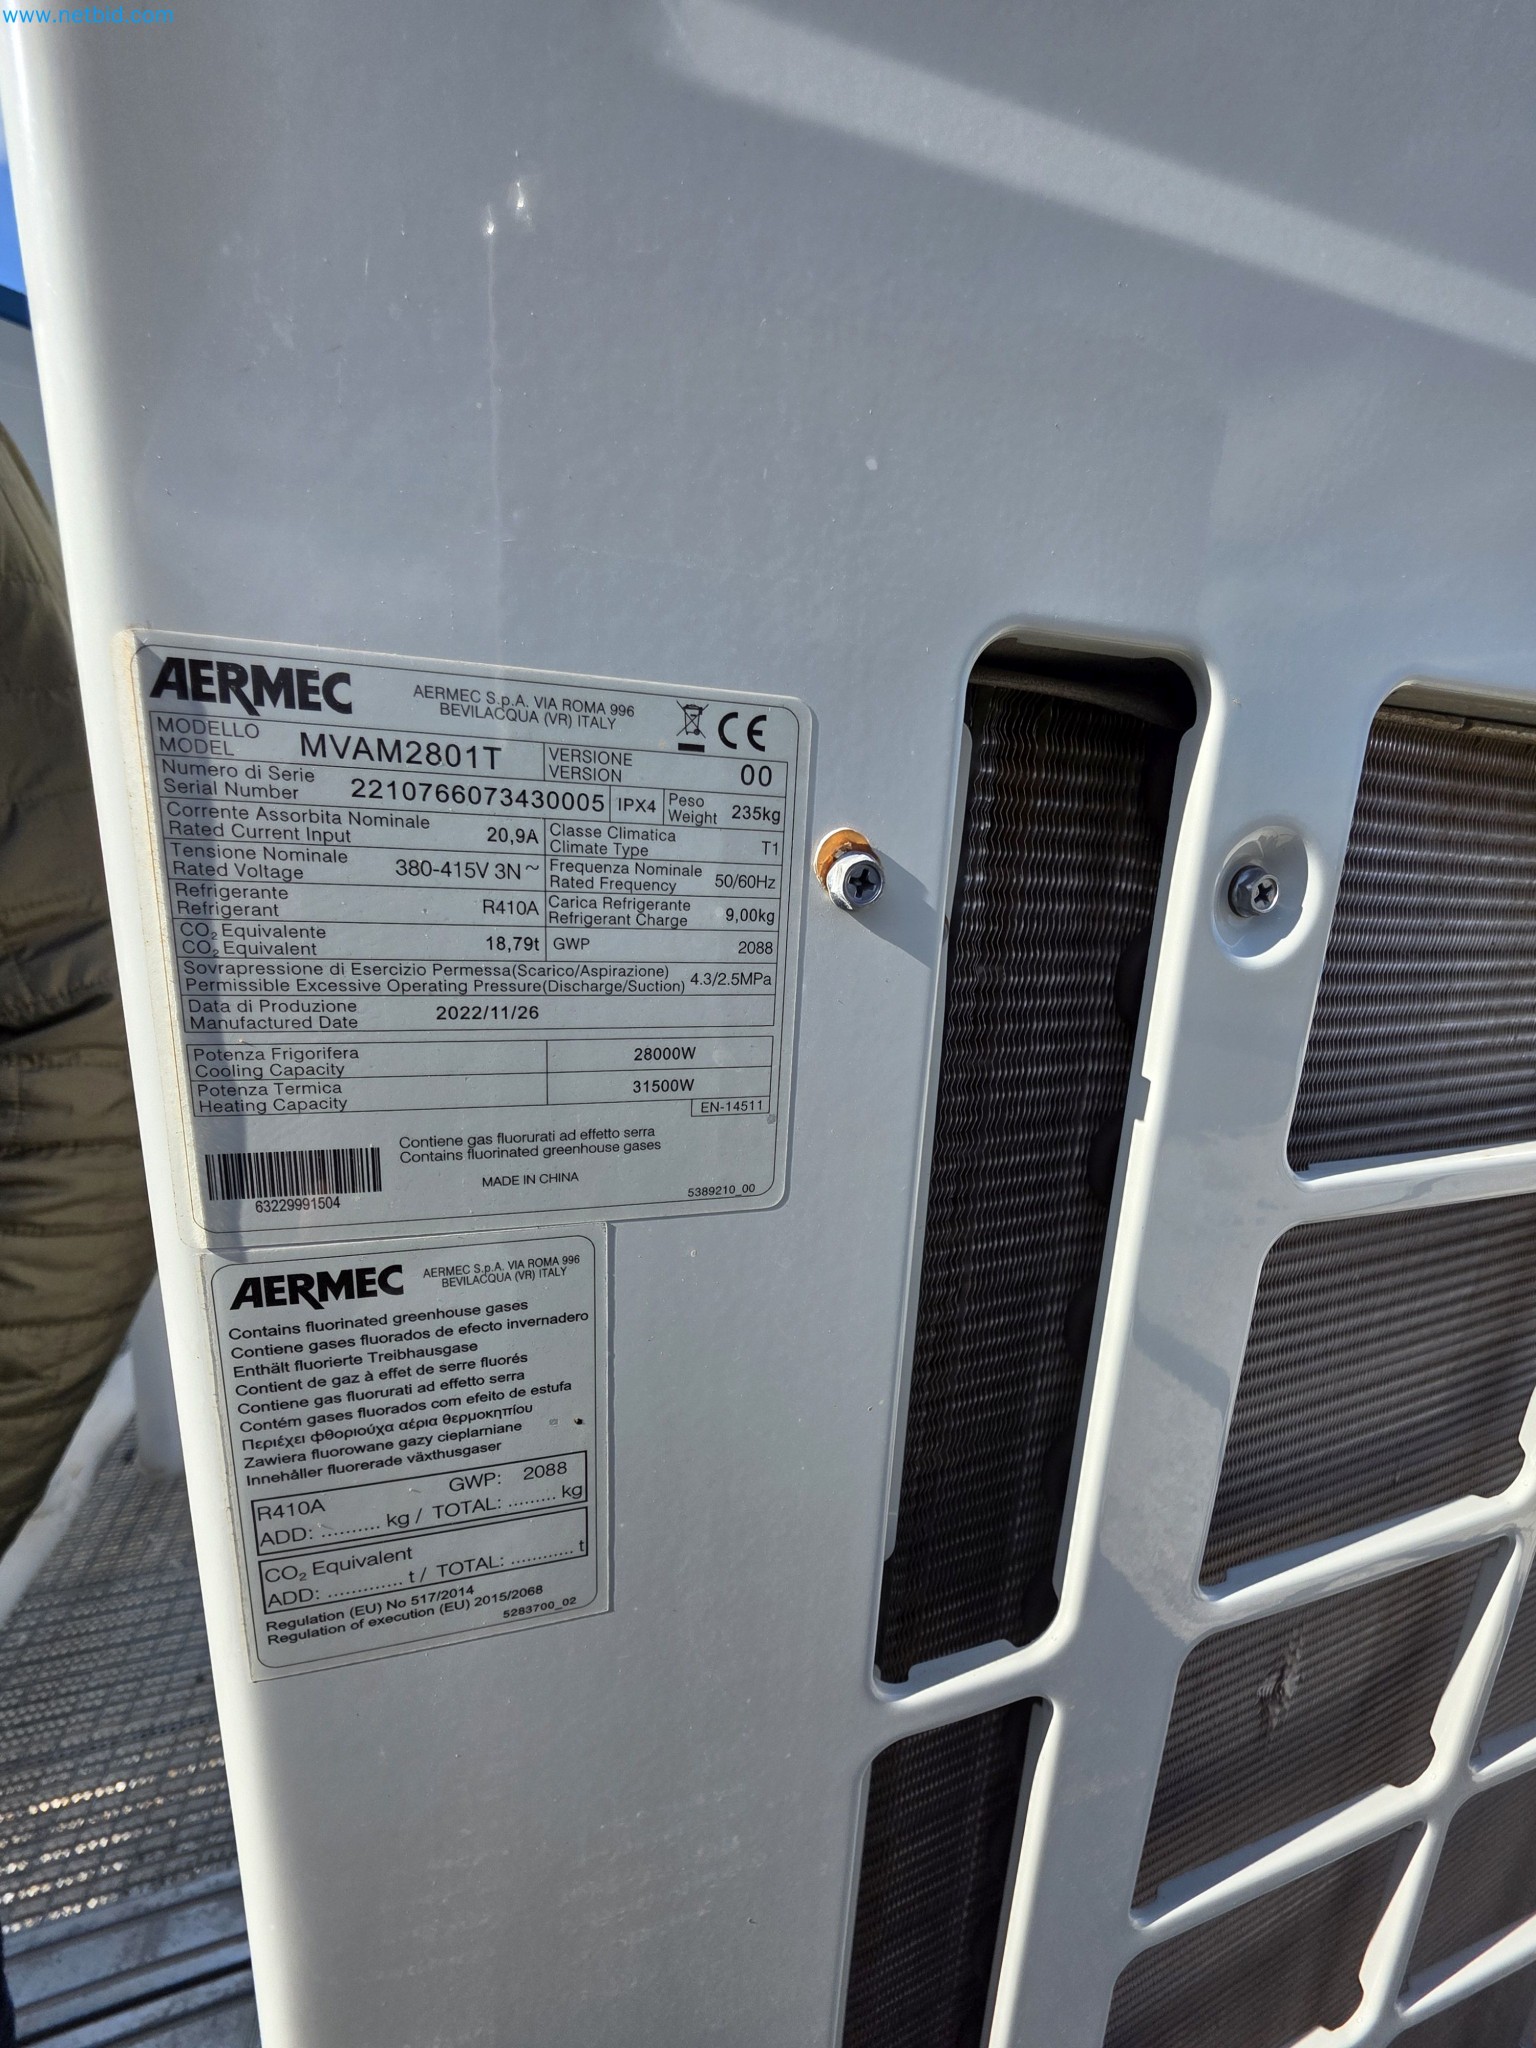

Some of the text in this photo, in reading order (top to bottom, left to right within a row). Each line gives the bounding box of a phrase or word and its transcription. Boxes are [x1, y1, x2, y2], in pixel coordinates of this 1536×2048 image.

[150, 657, 352, 716] AERMEC
[413, 685, 635, 717] AERMEC S.p.A. VIA ROMA 996
[440, 703, 616, 730] BEVILACQUA (VR) ITALY
[157, 717, 259, 739] MODELLO
[159, 737, 235, 757] MODEL
[300, 732, 502, 769] MVAM2801T
[549, 747, 632, 766] VERSIONE
[162, 759, 315, 782] Numero di Serie
[549, 765, 621, 783] VERSION
[741, 764, 772, 787] 00
[164, 779, 298, 800] Serial Number
[351, 778, 604, 812] 2210766073430005
[618, 798, 656, 813] IPX4
[669, 793, 705, 807] Peso
[167, 802, 430, 829] Corrente Assorbita Nominale
[669, 809, 717, 826] Weight
[732, 805, 781, 825] 235kg
[169, 821, 351, 844] Rated Current Input
[487, 827, 539, 845] 20,9A
[550, 823, 676, 842] Classe Climatica
[171, 843, 348, 863] Tensione Nominale
[550, 840, 648, 859] Climate Type
[762, 841, 779, 856] T1
[173, 862, 303, 883] Rated Voltage
[396, 859, 489, 879] 380-415V
[550, 859, 702, 877] Frequenza Nominale
[550, 875, 677, 896] Rated Frequency
[715, 874, 776, 890] 50/60Hz
[175, 883, 289, 901] Refrigerante
[177, 901, 279, 919] Refrigerant
[483, 900, 539, 915] R410A
[549, 895, 691, 914] Carica Refrigerante
[549, 911, 688, 930] Refrigerant Charge
[726, 908, 774, 925] 9,00kg
[486, 936, 540, 953] 18,79t
[553, 938, 590, 950] GWP
[738, 941, 773, 955] 2088
[184, 961, 323, 977] Sovrapressione
[330, 963, 345, 975] di
[351, 963, 426, 976] Esercizio
[186, 978, 290, 992] Permissible
[296, 979, 381, 992] Excessive
[387, 979, 468, 995] Operating
[690, 972, 772, 987] 4.3/2.5MPa
[189, 1000, 357, 1013] Data di Produzione
[436, 1006, 539, 1020] 2022/11/26
[190, 1016, 358, 1030] Manufactured Date
[194, 1048, 359, 1063] Potenza Frigorifera
[634, 1047, 696, 1061] 28000W
[195, 1063, 345, 1079] Cooling Capacity
[197, 1082, 342, 1097] Potenza Termica
[633, 1079, 695, 1093] 31500W
[200, 1098, 347, 1114] Heating Capacity
[701, 1100, 763, 1113] EN-14511
[400, 1126, 655, 1149] Contiene gas fluorurati ad effetto serra
[482, 1172, 579, 1188] MADE IN CHINA
[688, 1183, 755, 1198] 5389210_00
[255, 1196, 340, 1213] 63229991504
[230, 1264, 404, 1310] AERMEC
[229, 1302, 529, 1340] Contains fluorinated greenhouse gases
[231, 1312, 589, 1359] Contiene gases fluorados de efecto invernadero
[233, 1342, 478, 1378] Enthält fluorierte Treibhausgase
[235, 1353, 528, 1396] Contient de gaz à effet de serre fluorés
[240, 1382, 572, 1433] Contém gases fluorados com efeito de estufa
[242, 1436, 305, 1451] Περιέχει
[244, 1422, 522, 1469] Zawiera fluorowane gazy cieplarniane
[247, 1442, 502, 1486] Innehåller fluorerade växthusgaser
[449, 1462, 567, 1491] GWP: 2088
[258, 1499, 326, 1521] R410A
[266, 1586, 474, 1632] Regulation (EU) No 517/2014
[268, 1585, 543, 1645] Regulation of execution (EU) 2015/2068
[503, 1597, 577, 1618] 5283700_02
